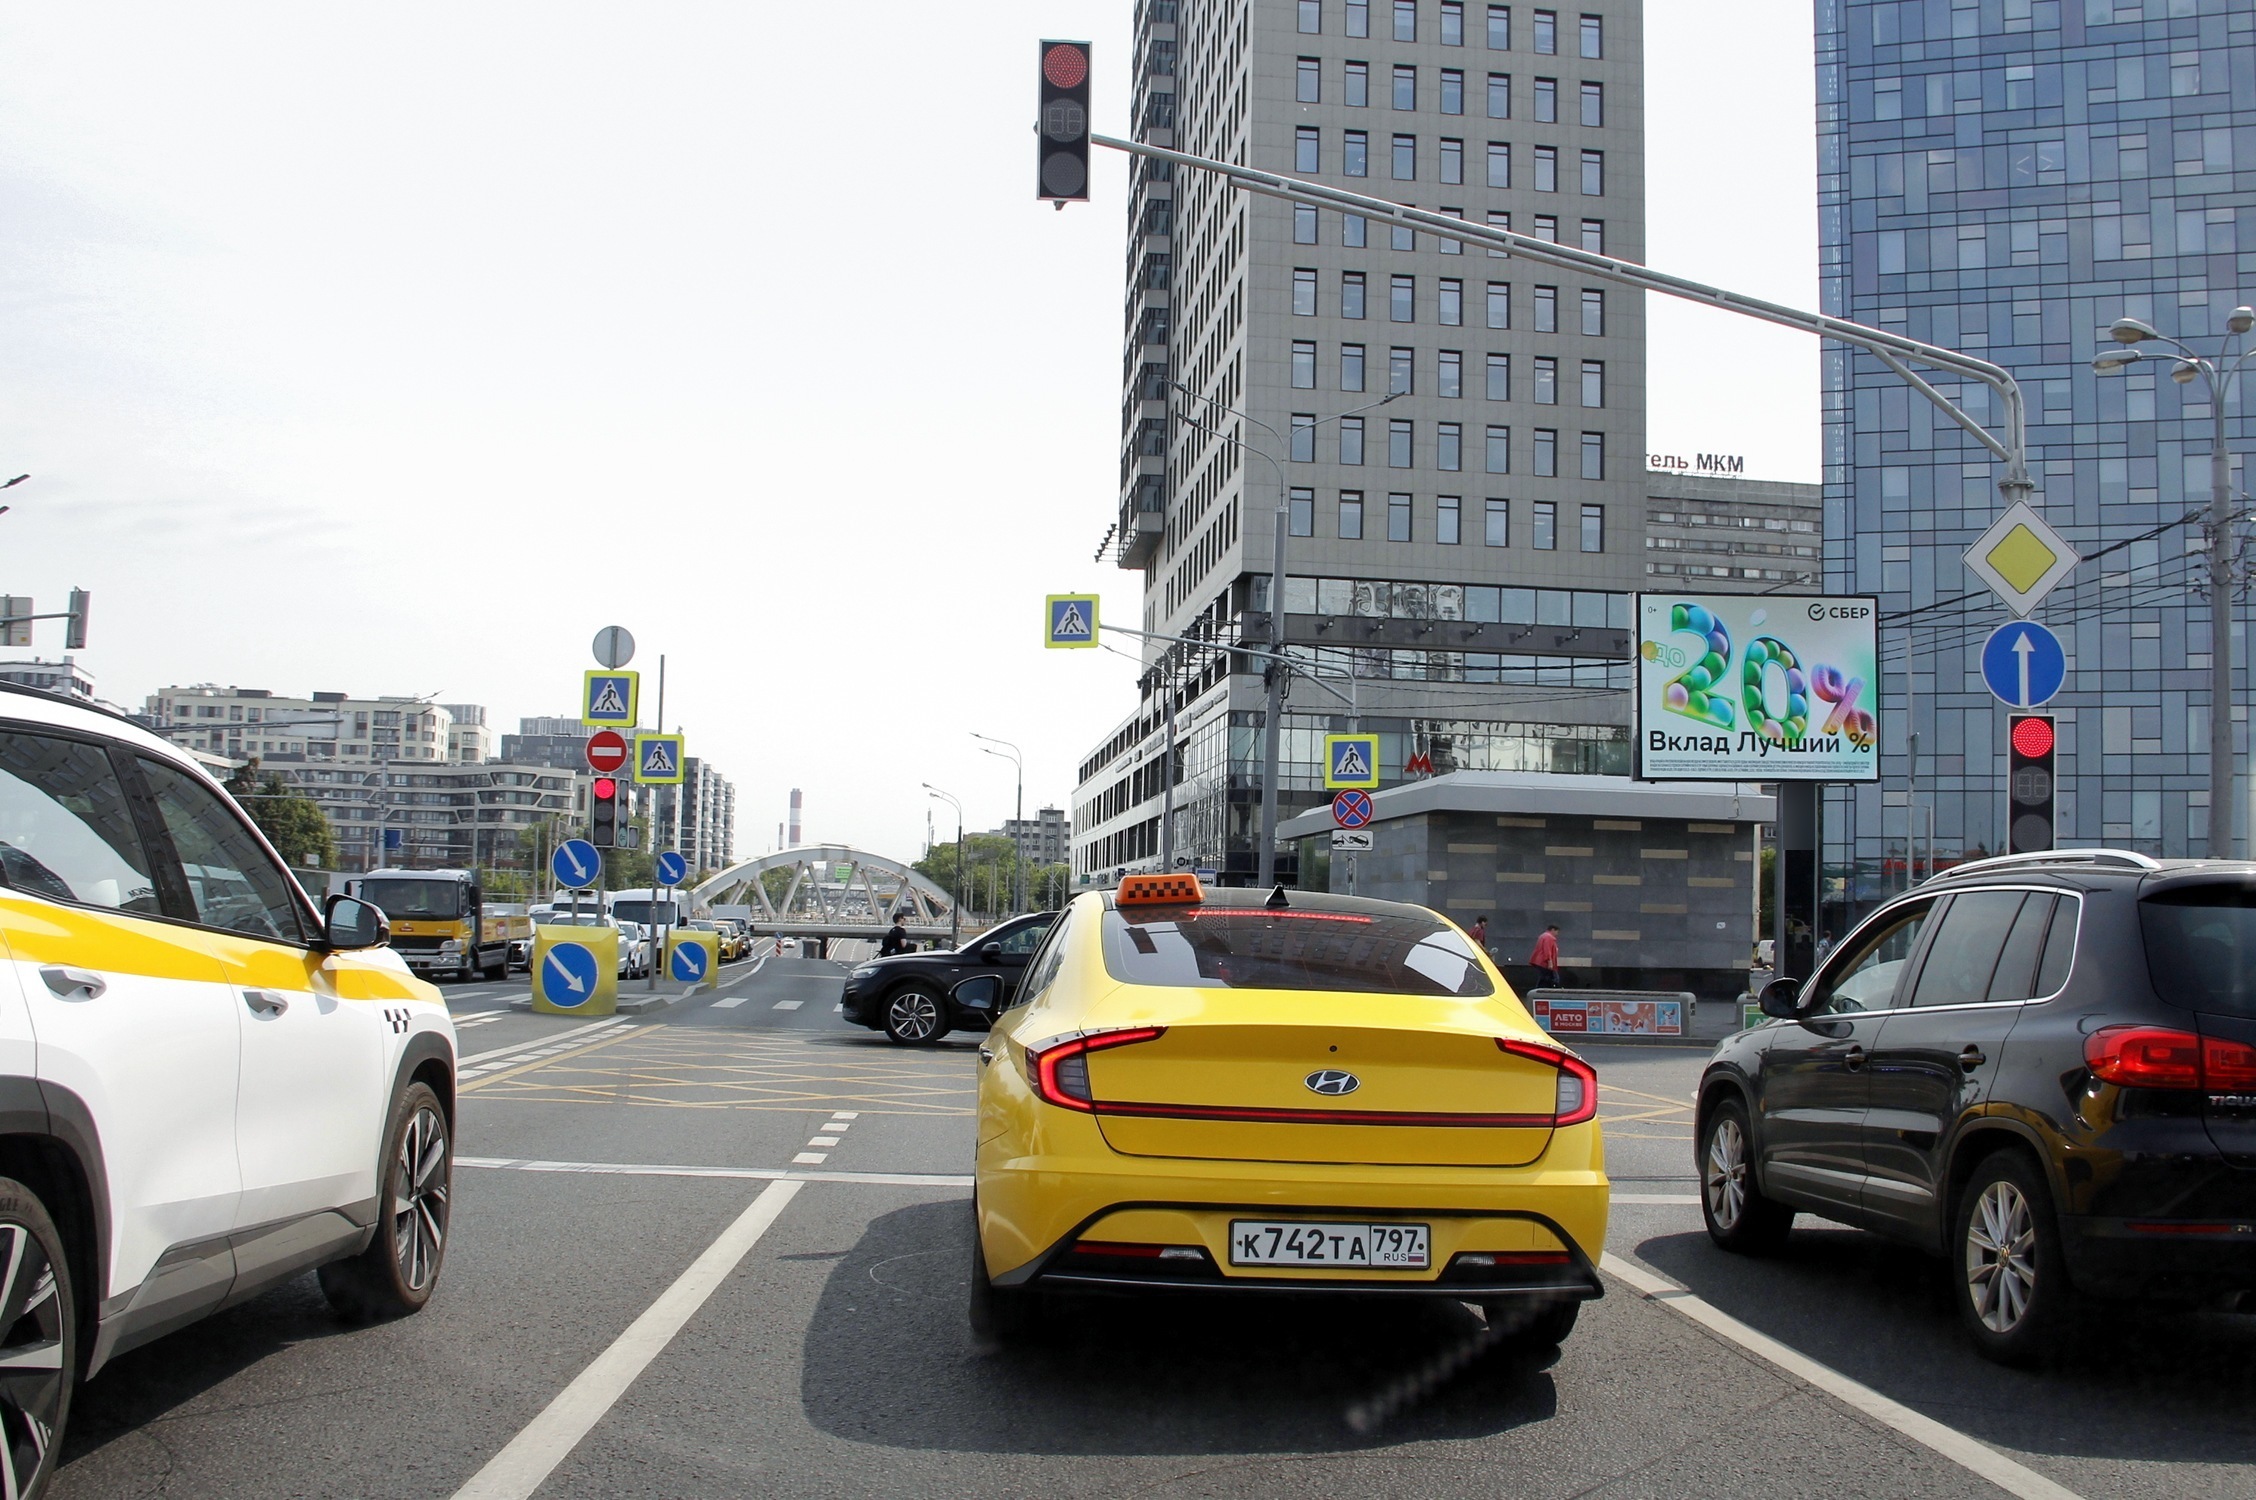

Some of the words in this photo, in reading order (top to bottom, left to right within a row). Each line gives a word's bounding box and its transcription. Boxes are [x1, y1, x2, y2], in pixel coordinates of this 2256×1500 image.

[1697, 453, 1744, 473] МКМ
[1648, 606, 1657, 614] 0+
[1829, 607, 1870, 619] СБЕР
[1649, 731, 1730, 754] Вклад
[1737, 731, 1840, 757] Лучший
[1849, 733, 1871, 754] %
[1403, 751, 1435, 772] М
[1555, 1013, 1583, 1021] ЛЕТО
[1244, 1227, 1366, 1261] К742ТА
[1373, 1228, 1418, 1253] 797
[1384, 1252, 1407, 1262] RUS
